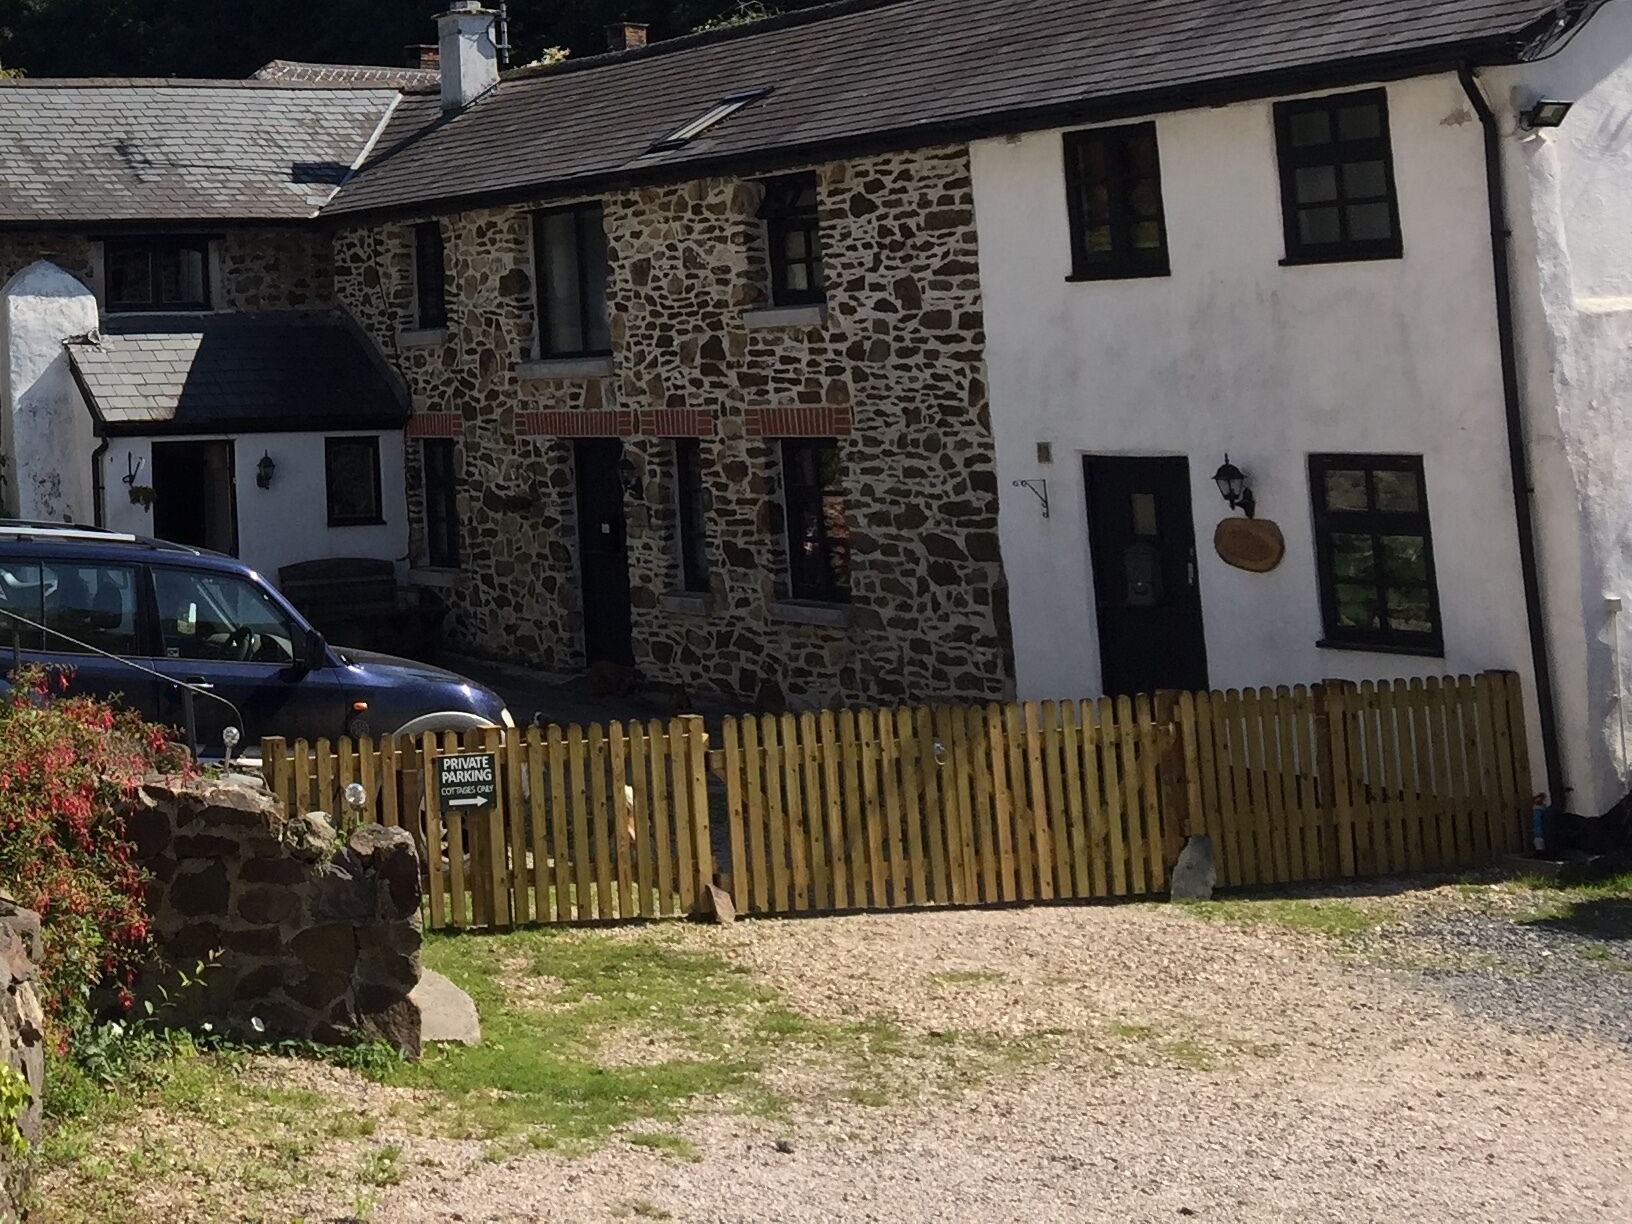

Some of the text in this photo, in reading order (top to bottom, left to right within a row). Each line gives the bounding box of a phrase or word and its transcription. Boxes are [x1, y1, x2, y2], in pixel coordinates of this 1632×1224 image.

[443, 756, 489, 770] PRIVATE
[441, 768, 492, 783] PARKING
[441, 785, 494, 795] COTTAGES ONLY
